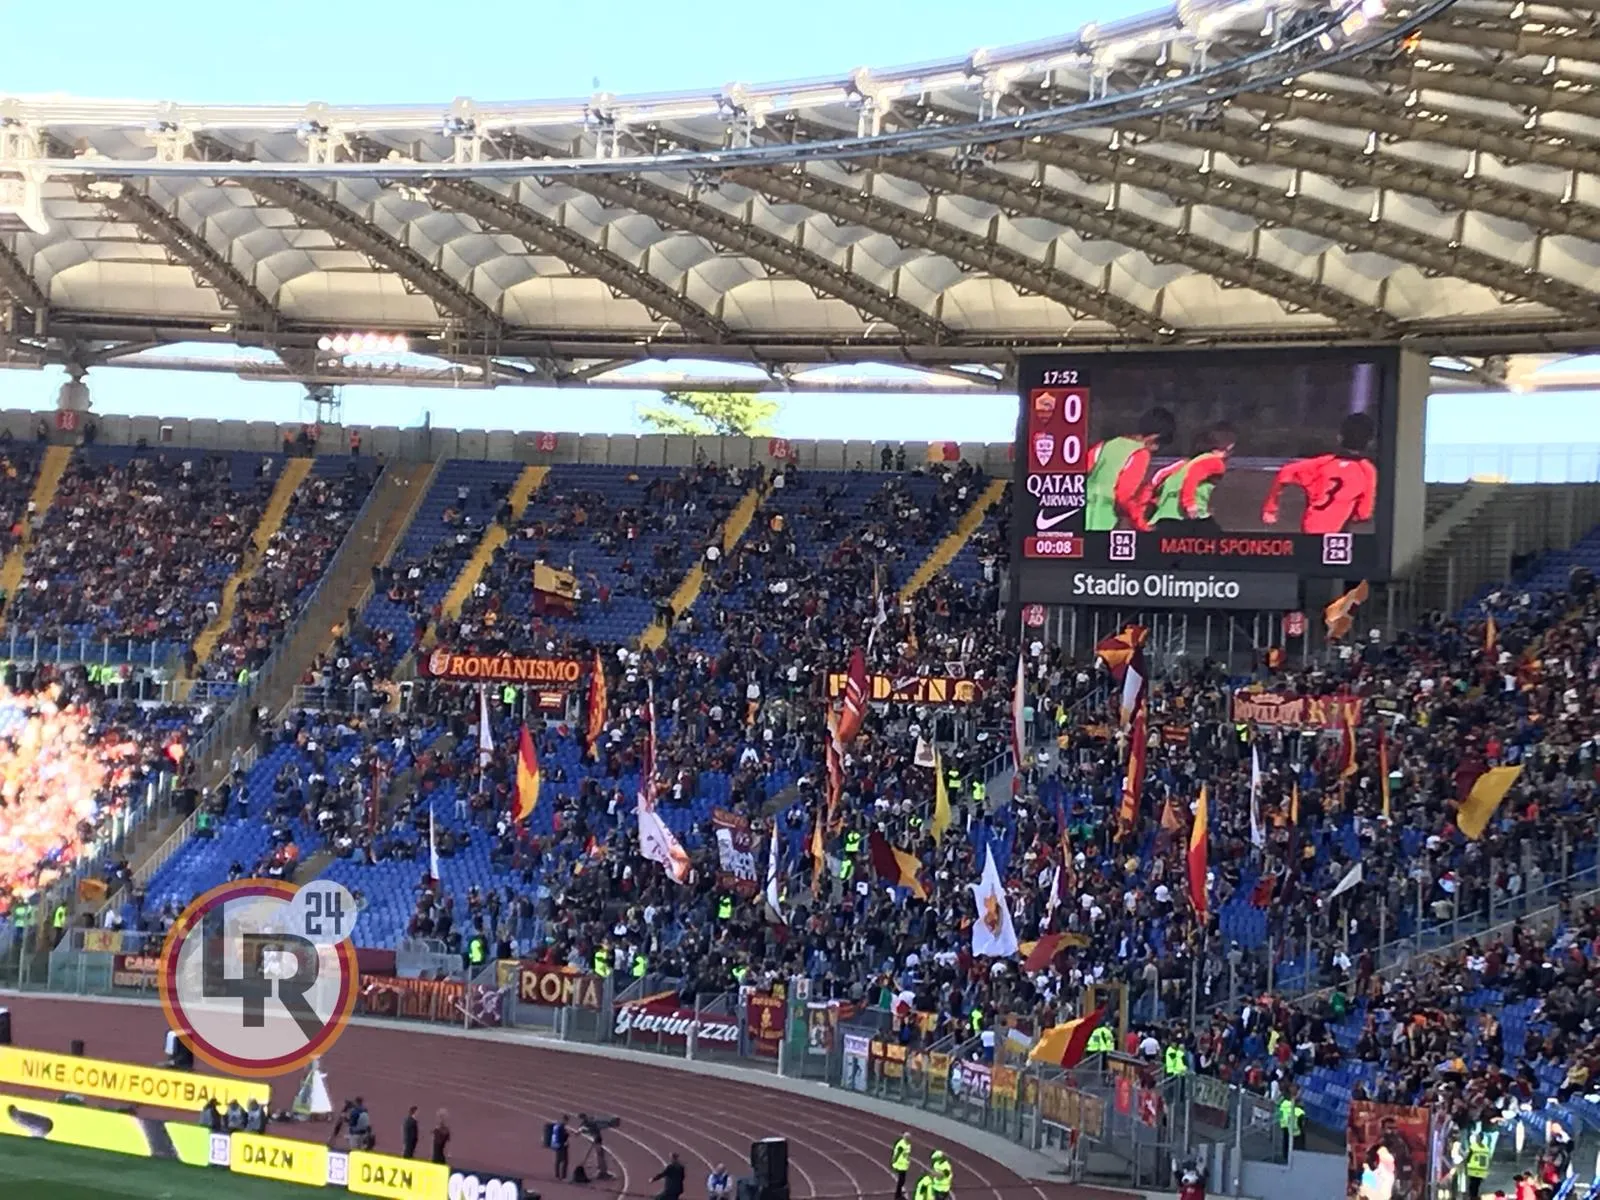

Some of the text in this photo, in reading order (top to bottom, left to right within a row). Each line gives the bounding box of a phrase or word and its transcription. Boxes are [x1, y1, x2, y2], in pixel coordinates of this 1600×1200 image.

[1043, 371, 1078, 385] 17:52
[1064, 394, 1082, 423] 0
[1063, 435, 1081, 465] 0
[1026, 474, 1086, 498] QATAR
[1312, 476, 1344, 511] 3
[1039, 495, 1086, 507] AIRWAYS
[1036, 540, 1073, 554] 00:08
[1160, 537, 1294, 556] MATCH SPONSOR
[1072, 573, 1240, 602] Stadio Olimpico
[450, 656, 580, 682] ROMANISMO
[521, 971, 598, 1007] ROMA
[243, 1144, 294, 1169] DAZN
[361, 1163, 413, 1189] DAZN
